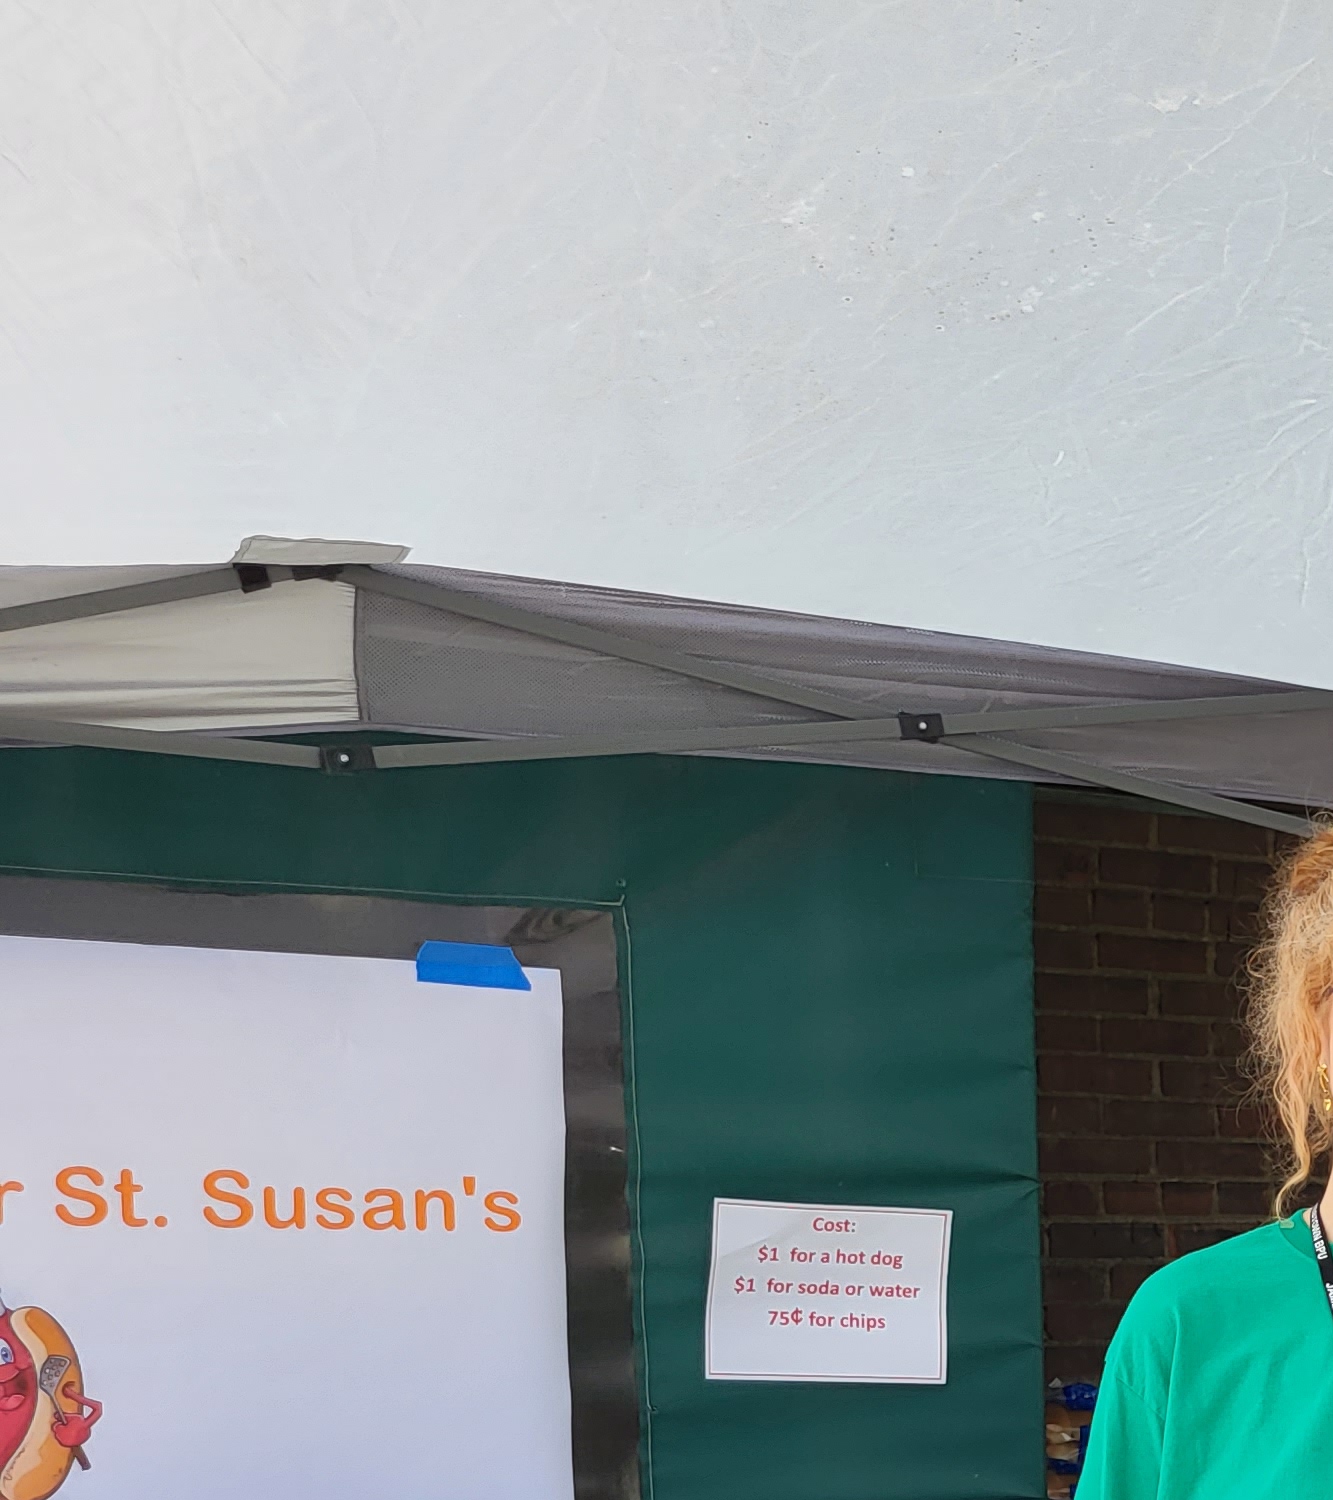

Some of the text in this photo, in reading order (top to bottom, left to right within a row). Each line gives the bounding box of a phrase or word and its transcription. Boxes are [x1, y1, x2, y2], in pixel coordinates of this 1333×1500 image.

[55, 1165, 168, 1228] St.
[202, 1169, 522, 1232] Susan's
[813, 1217, 856, 1233] Cost:
[758, 1244, 903, 1269] $1 for a hot dog
[1314, 1238, 1328, 1260] BPU
[734, 1275, 920, 1298] $1 for soda or water
[768, 1307, 886, 1332] 75¢ for chips
